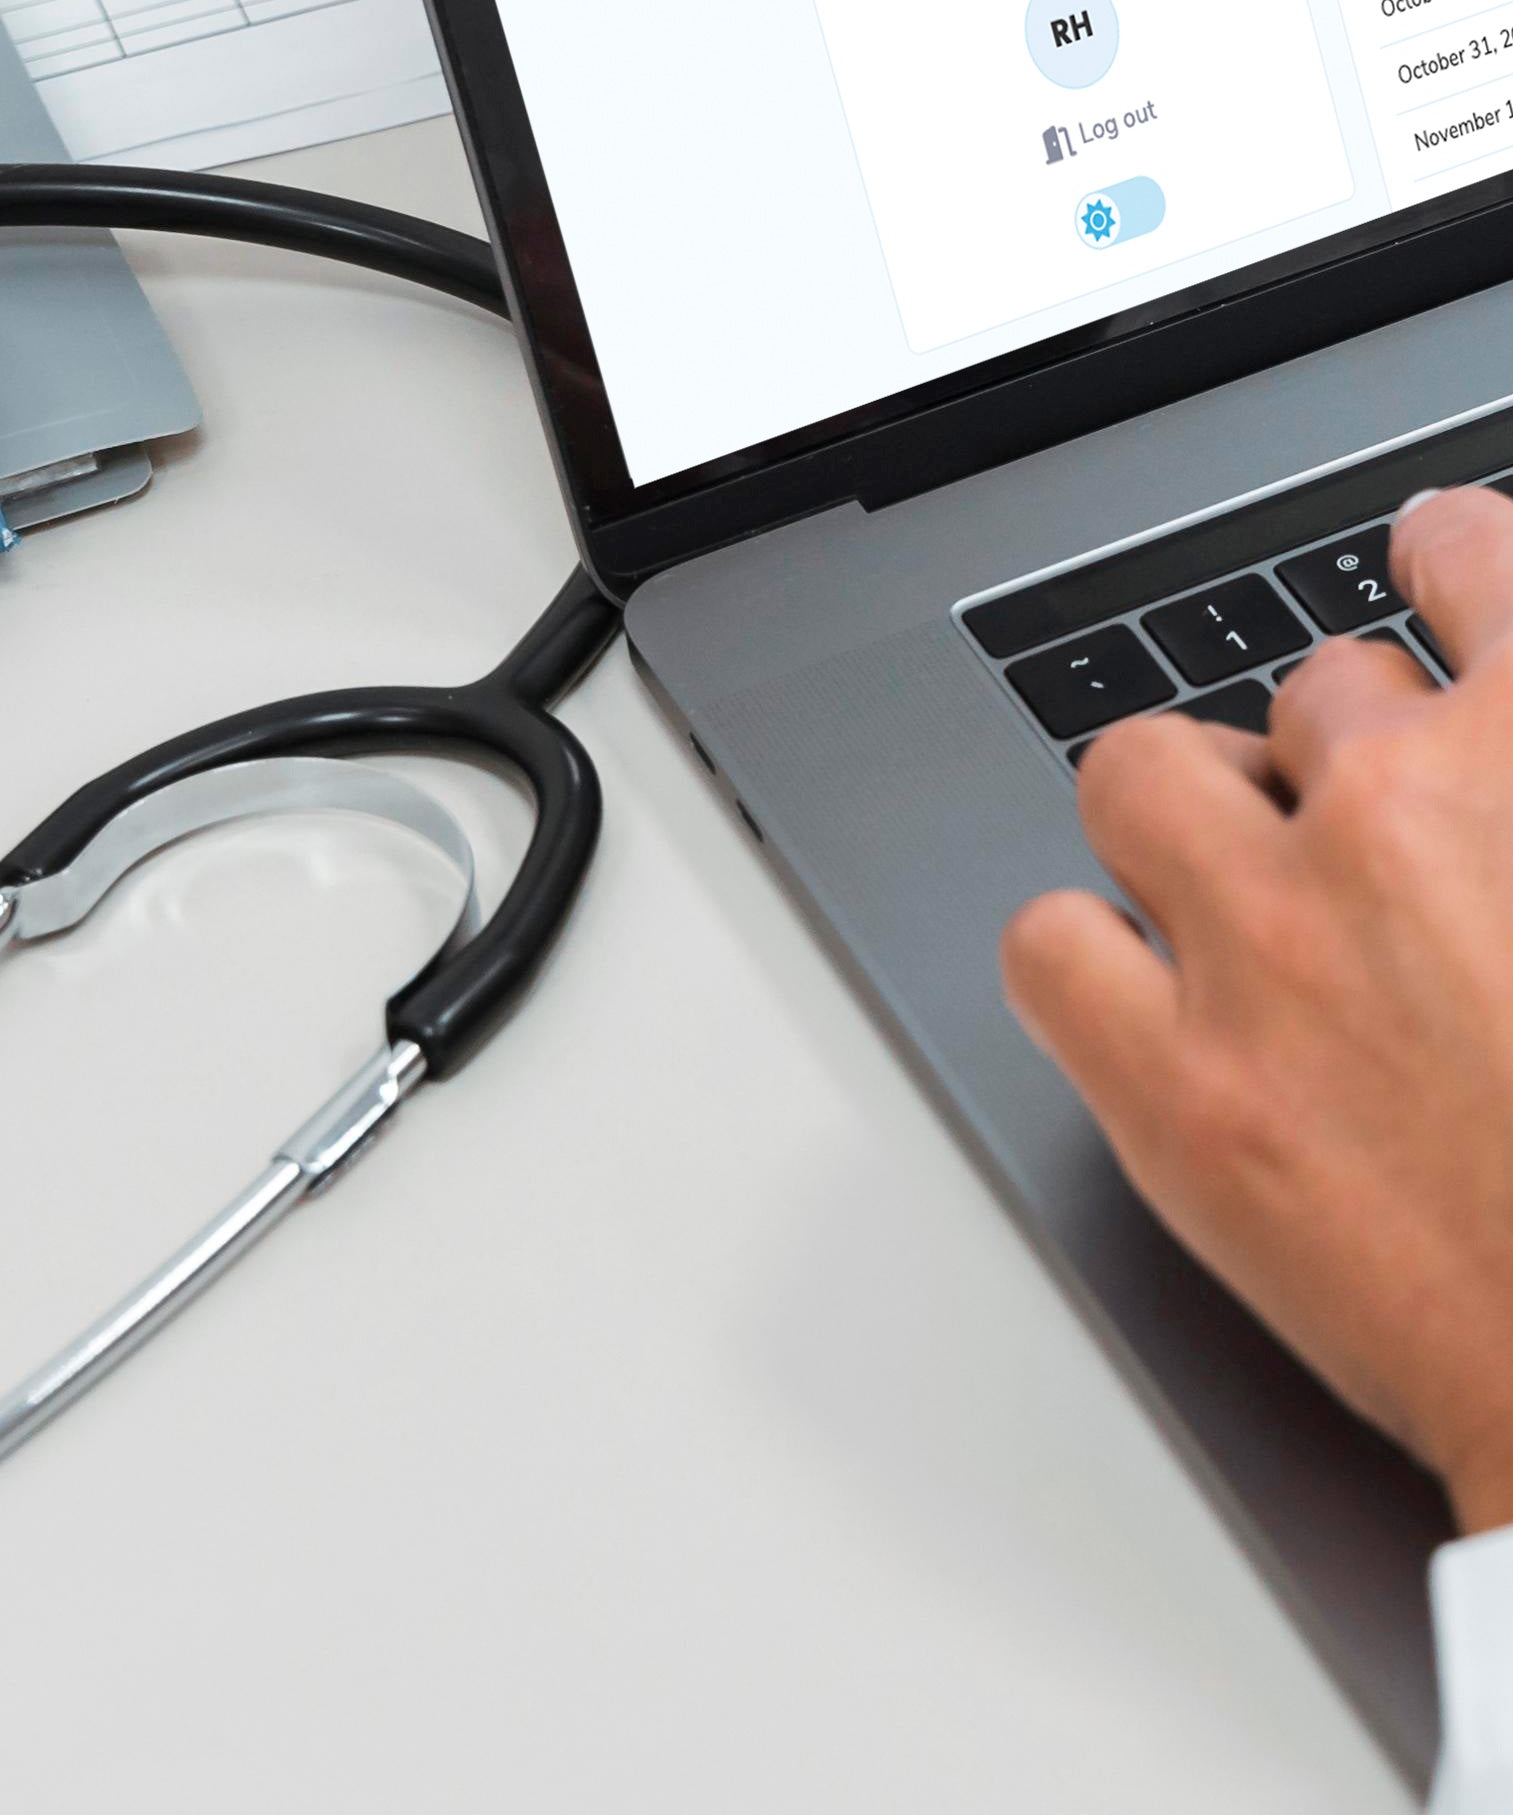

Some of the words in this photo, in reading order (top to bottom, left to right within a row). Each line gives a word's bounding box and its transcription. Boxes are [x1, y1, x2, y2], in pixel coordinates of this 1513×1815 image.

[1051, 10, 1093, 46] RH
[1398, 49, 1464, 83] October
[1469, 36, 1497, 58] 31,
[1079, 118, 1118, 143] Log
[1124, 101, 1157, 127] out
[1414, 109, 1500, 150] November
[1358, 580, 1386, 601] 2
[1226, 631, 1247, 649] 1
